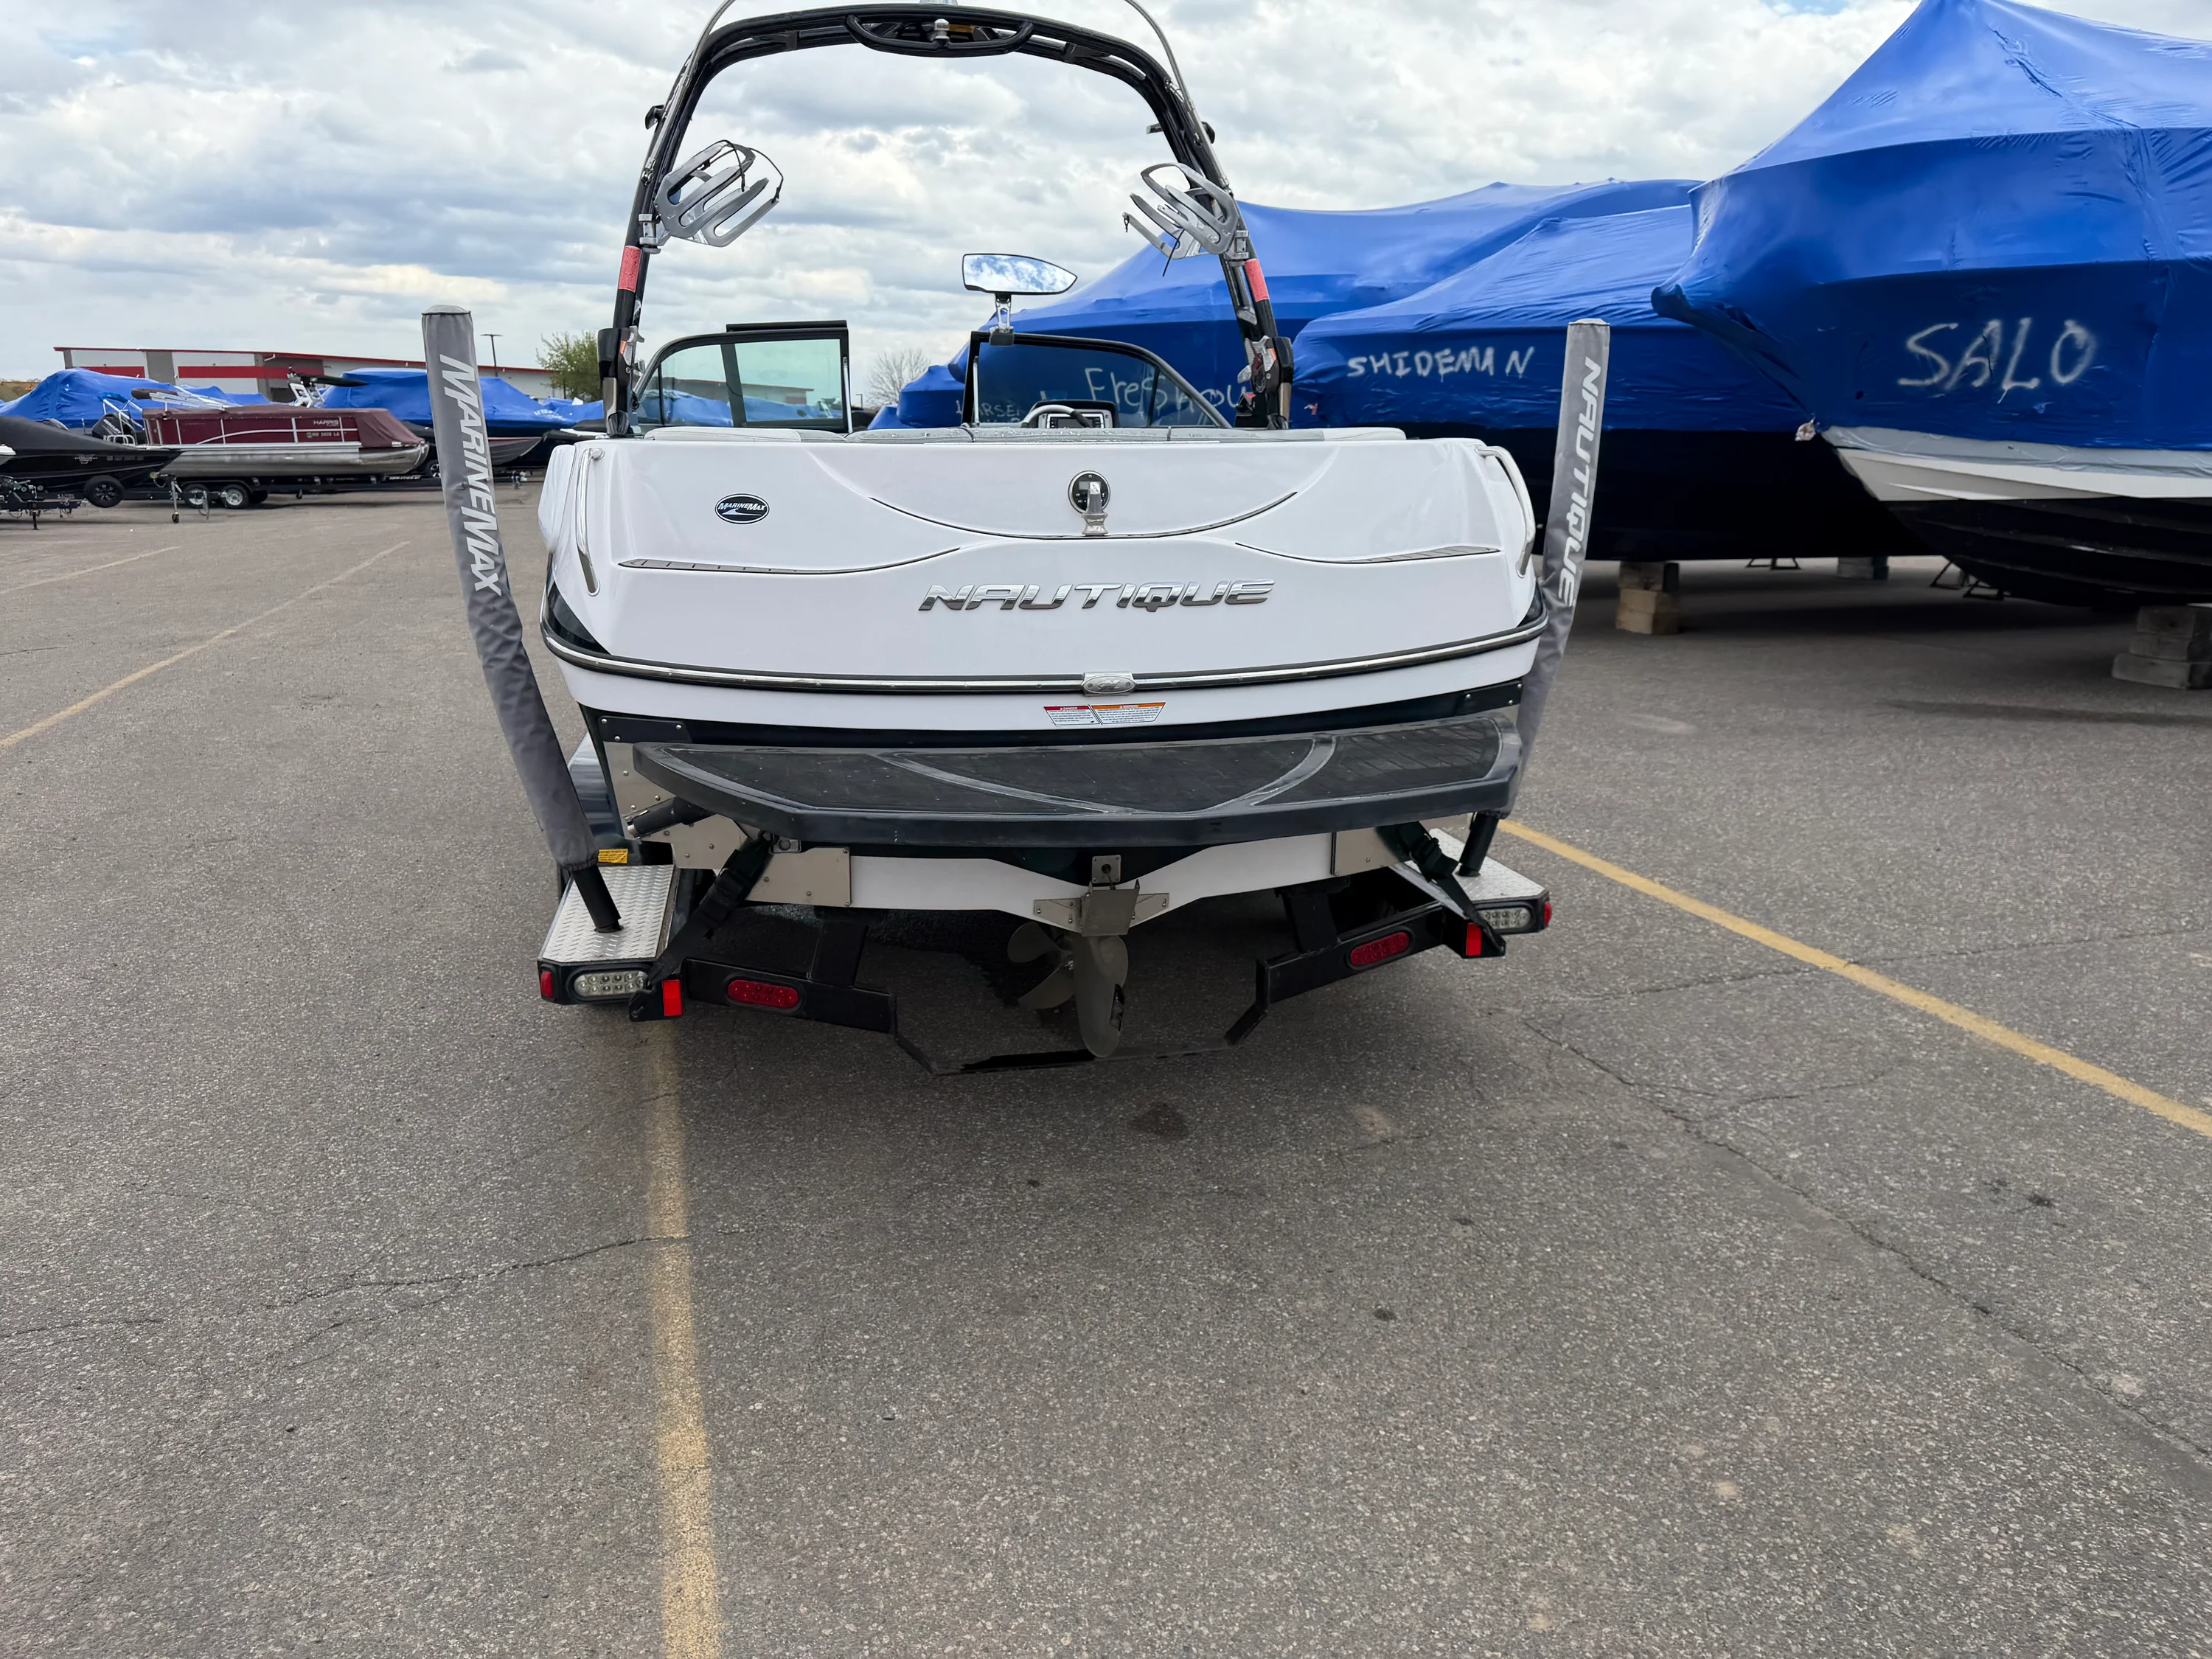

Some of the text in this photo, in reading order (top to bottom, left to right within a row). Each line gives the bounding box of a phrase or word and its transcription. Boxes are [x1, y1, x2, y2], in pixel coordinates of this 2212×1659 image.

[1897, 316, 2097, 392] SALO
[439, 354, 501, 597] MARINEMAX
[1558, 356, 1601, 607] NAUTIQUE
[918, 578, 1275, 613] NAUTIQUE
